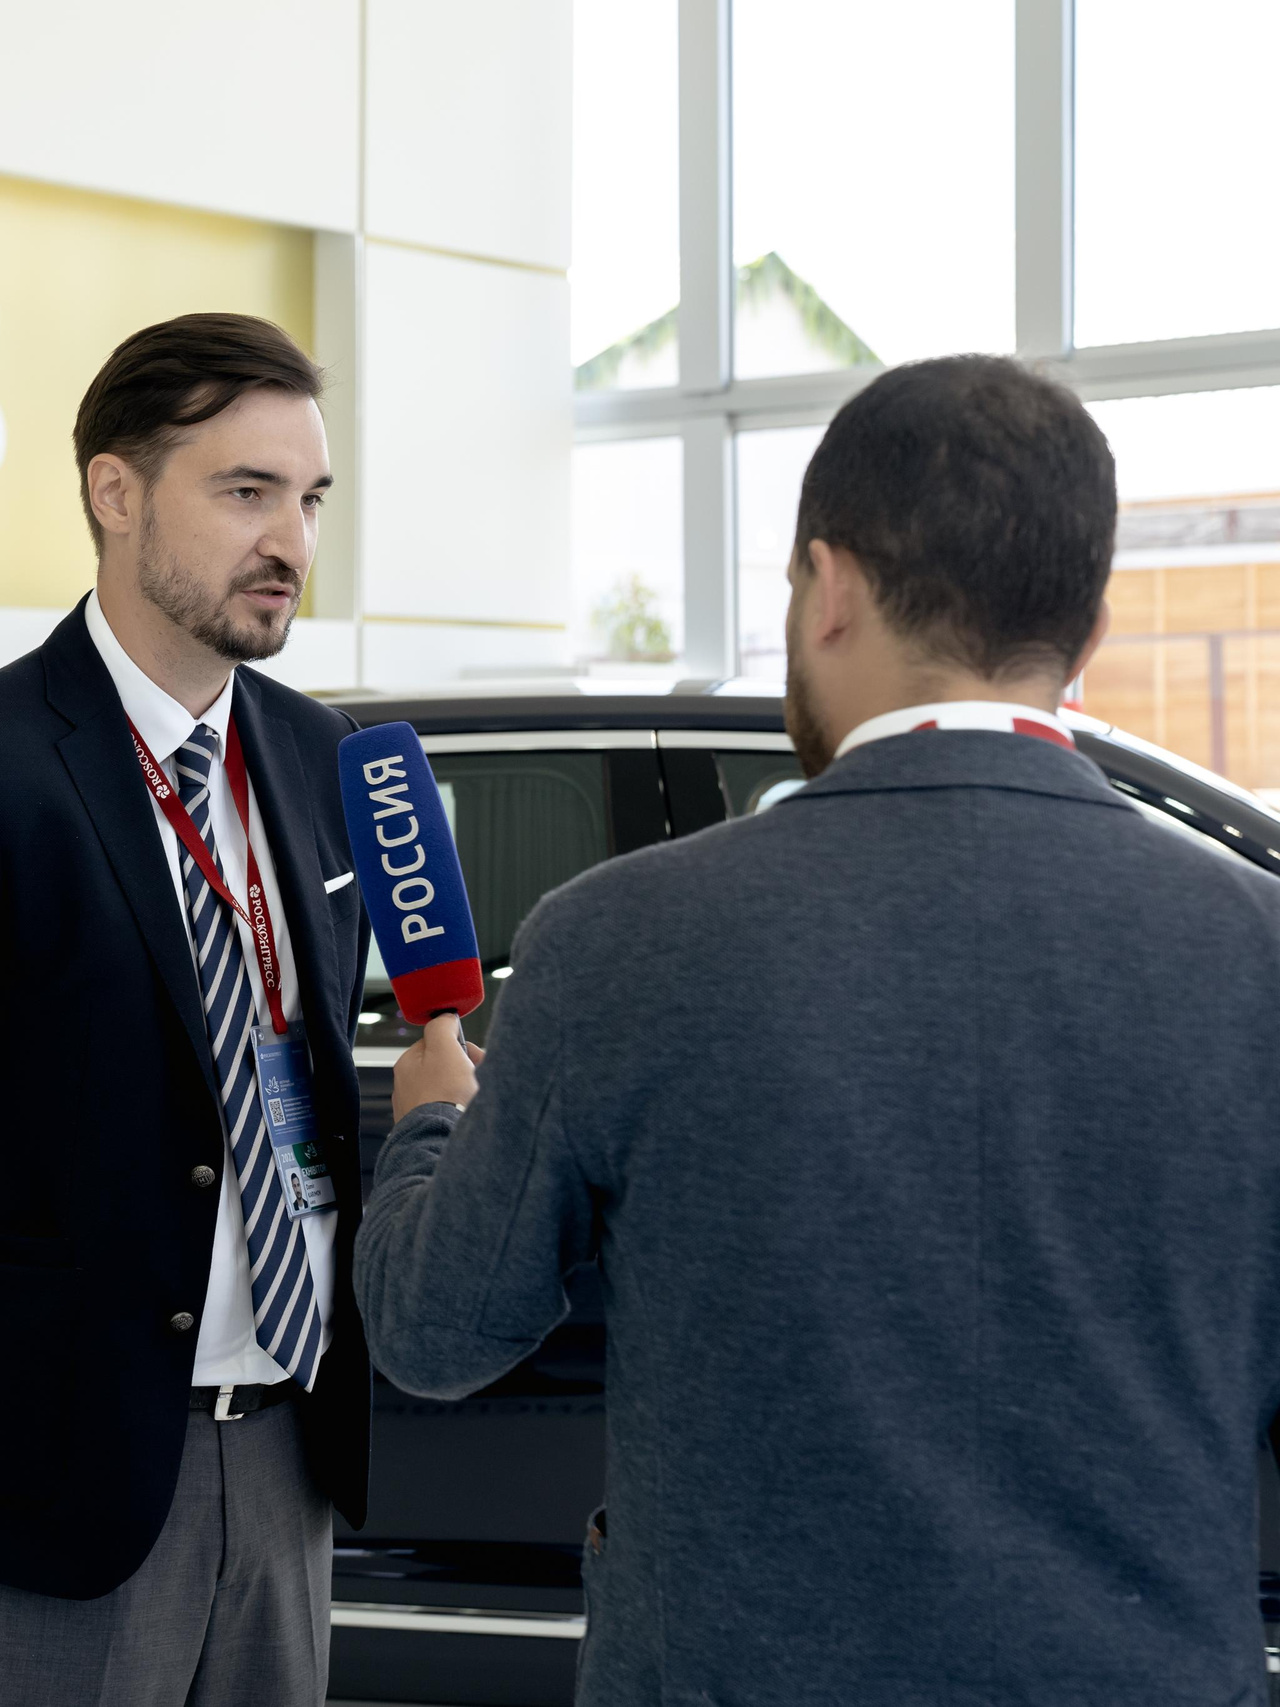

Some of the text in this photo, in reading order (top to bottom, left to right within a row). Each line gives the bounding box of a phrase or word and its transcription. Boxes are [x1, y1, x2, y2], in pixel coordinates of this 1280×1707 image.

[362, 754, 445, 944] РОССИЯ
[252, 899, 275, 988] РОСКОНГРЕСС
[281, 1152, 295, 1163] 2021
